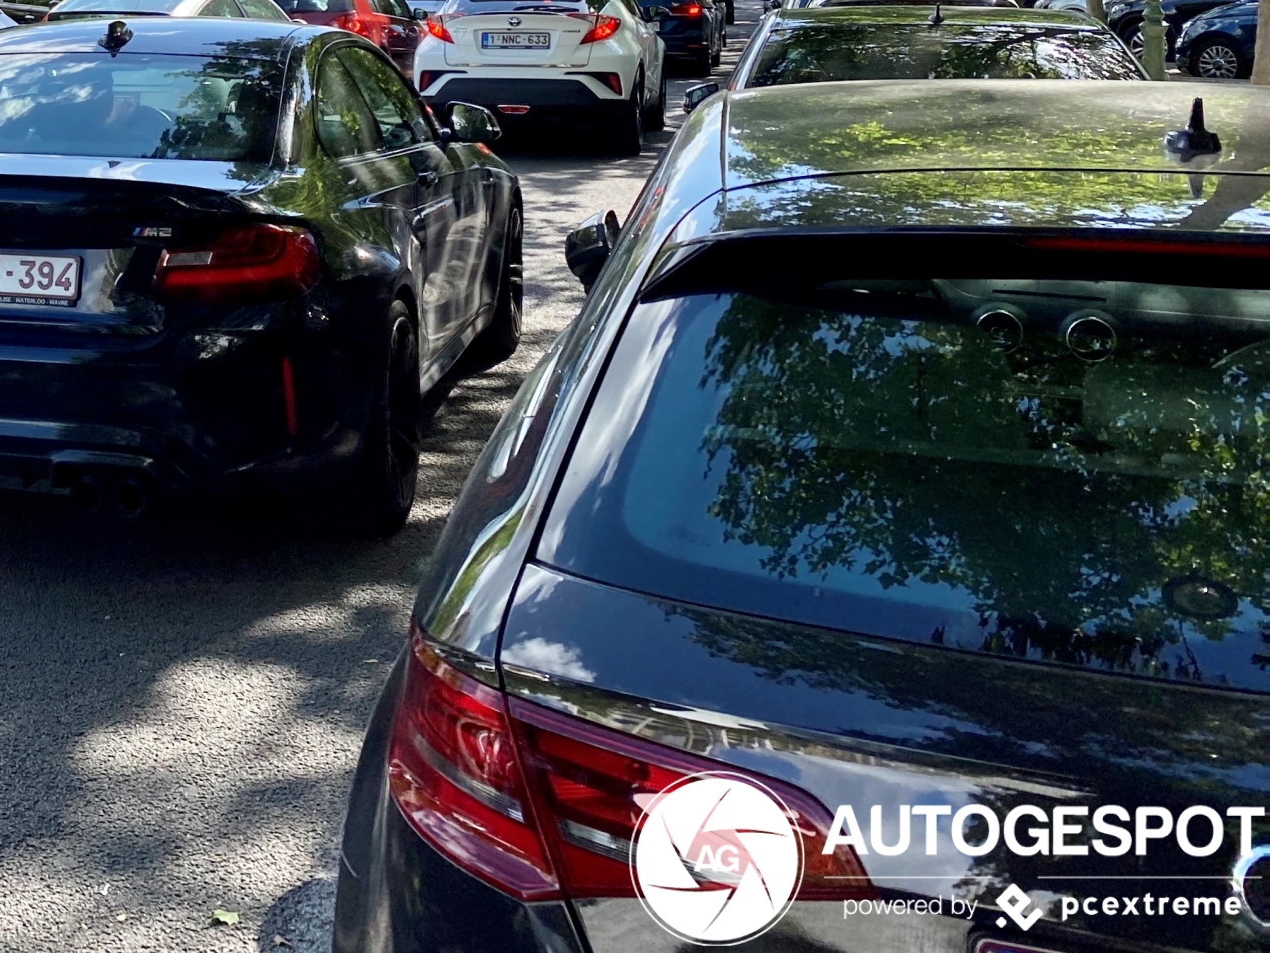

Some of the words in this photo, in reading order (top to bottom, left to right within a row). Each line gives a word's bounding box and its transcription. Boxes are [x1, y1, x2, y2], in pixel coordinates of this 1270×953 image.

[490, 35, 548, 45] 1-NNC-633
[143, 227, 172, 237] M2
[15, 297, 46, 305] WATERLOO
